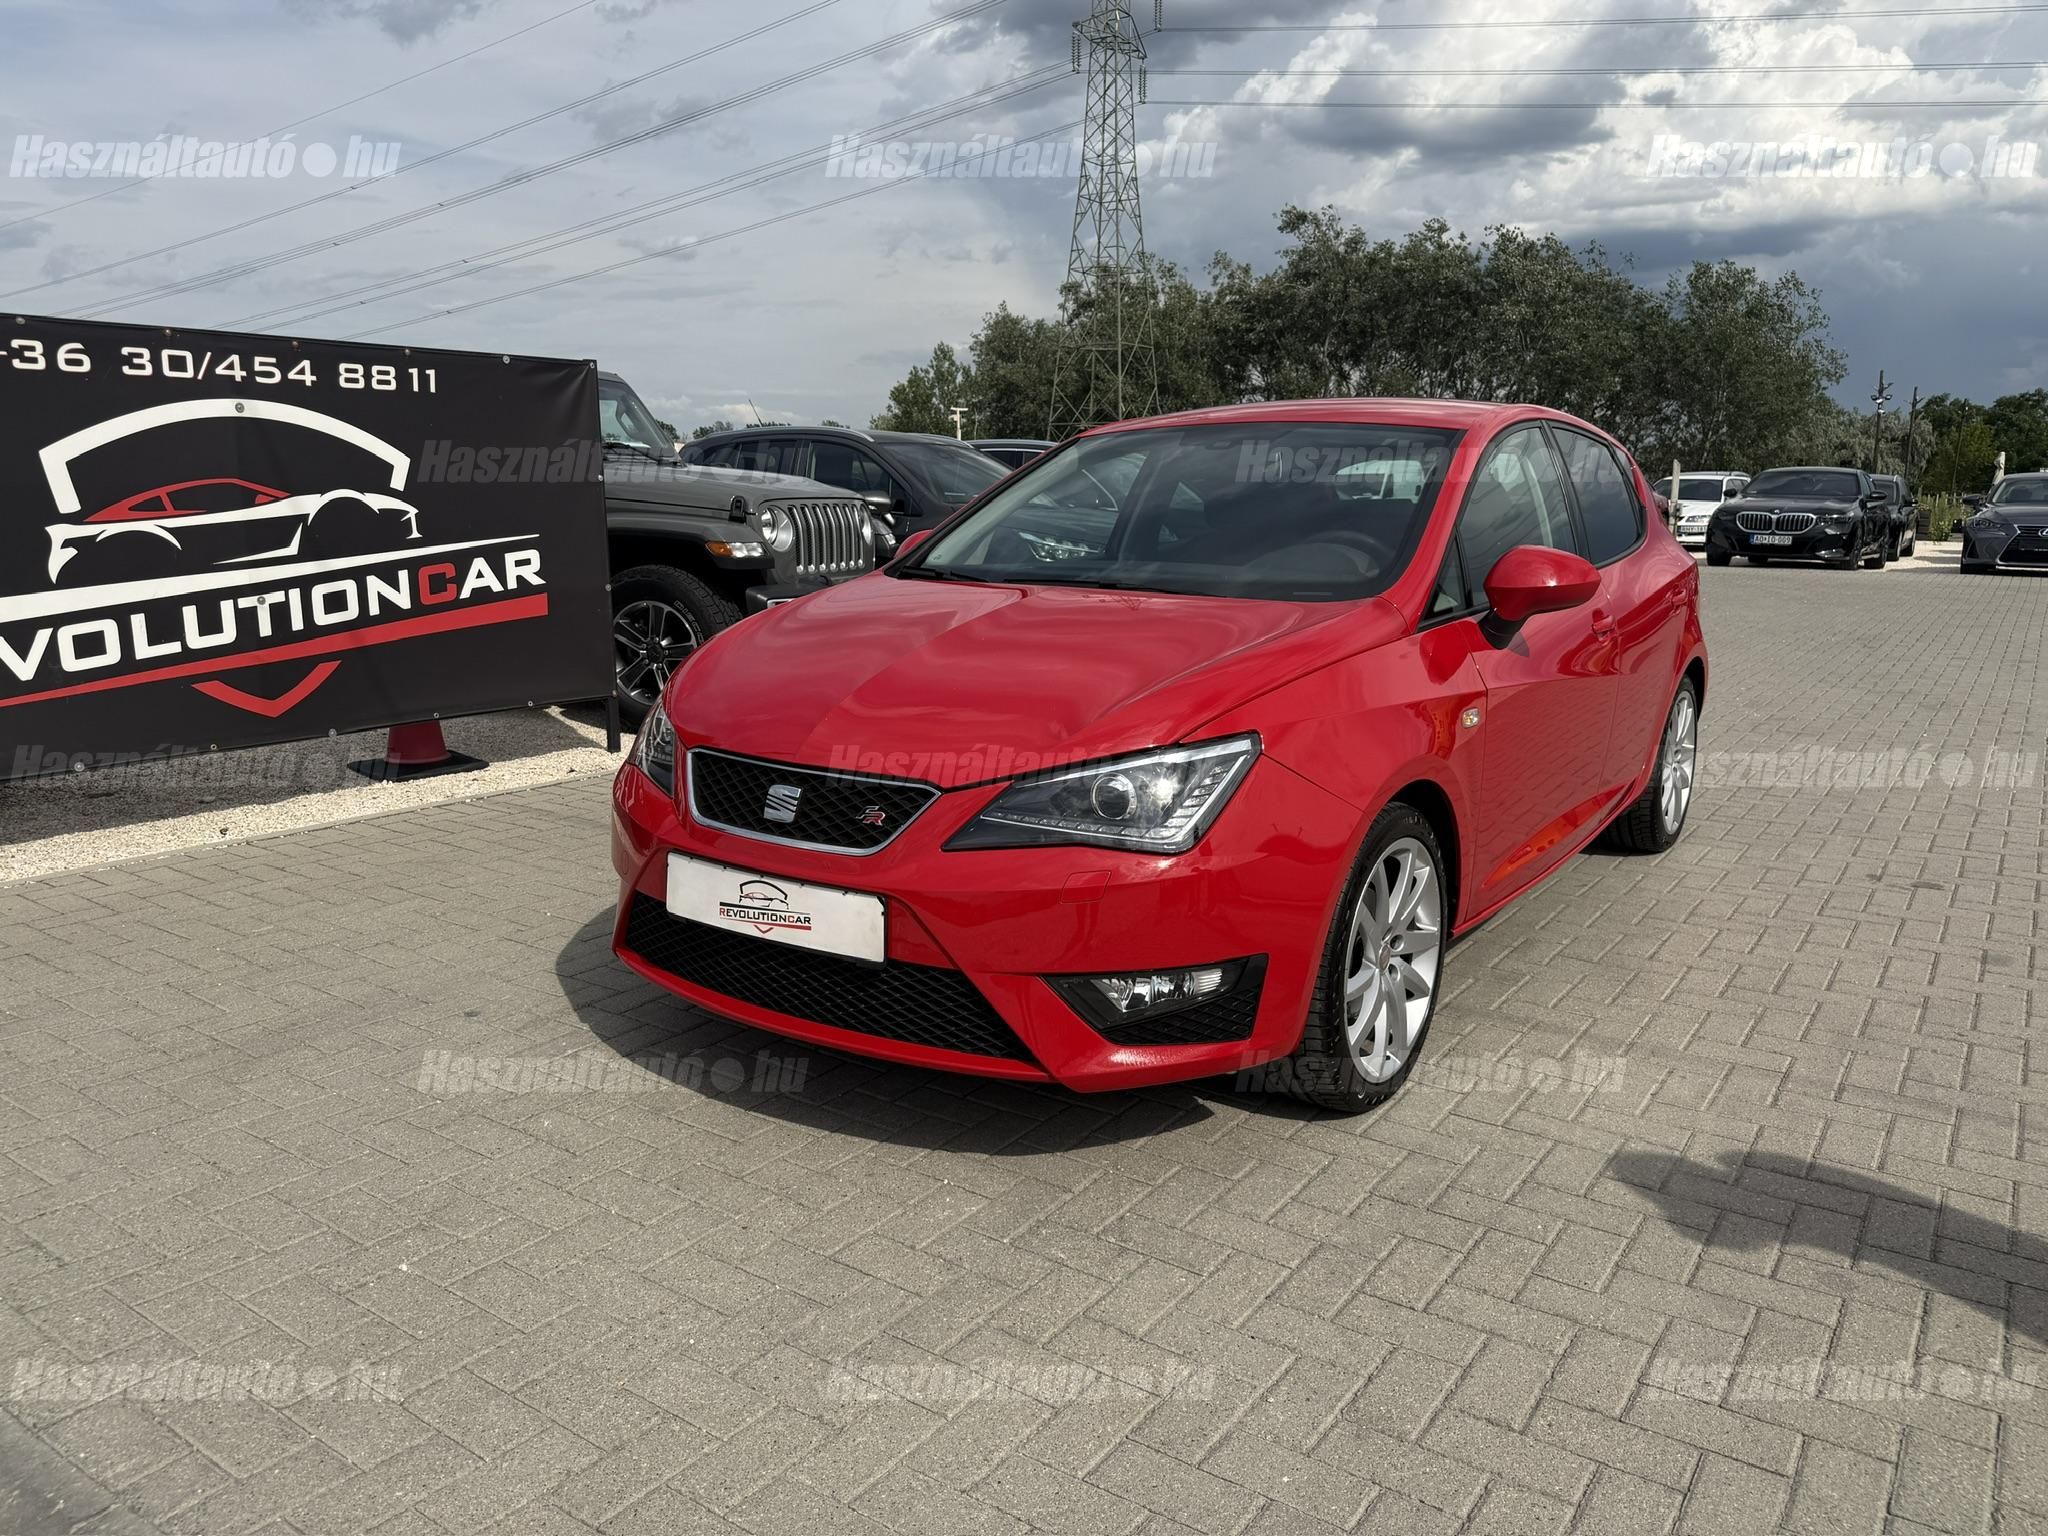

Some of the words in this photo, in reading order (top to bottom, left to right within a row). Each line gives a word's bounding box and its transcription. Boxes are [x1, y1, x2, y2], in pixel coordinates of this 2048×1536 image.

[0, 338, 92, 374] 36
[121, 345, 317, 387] 30/454
[719, 907, 812, 925] REVOLUTIONCAR
